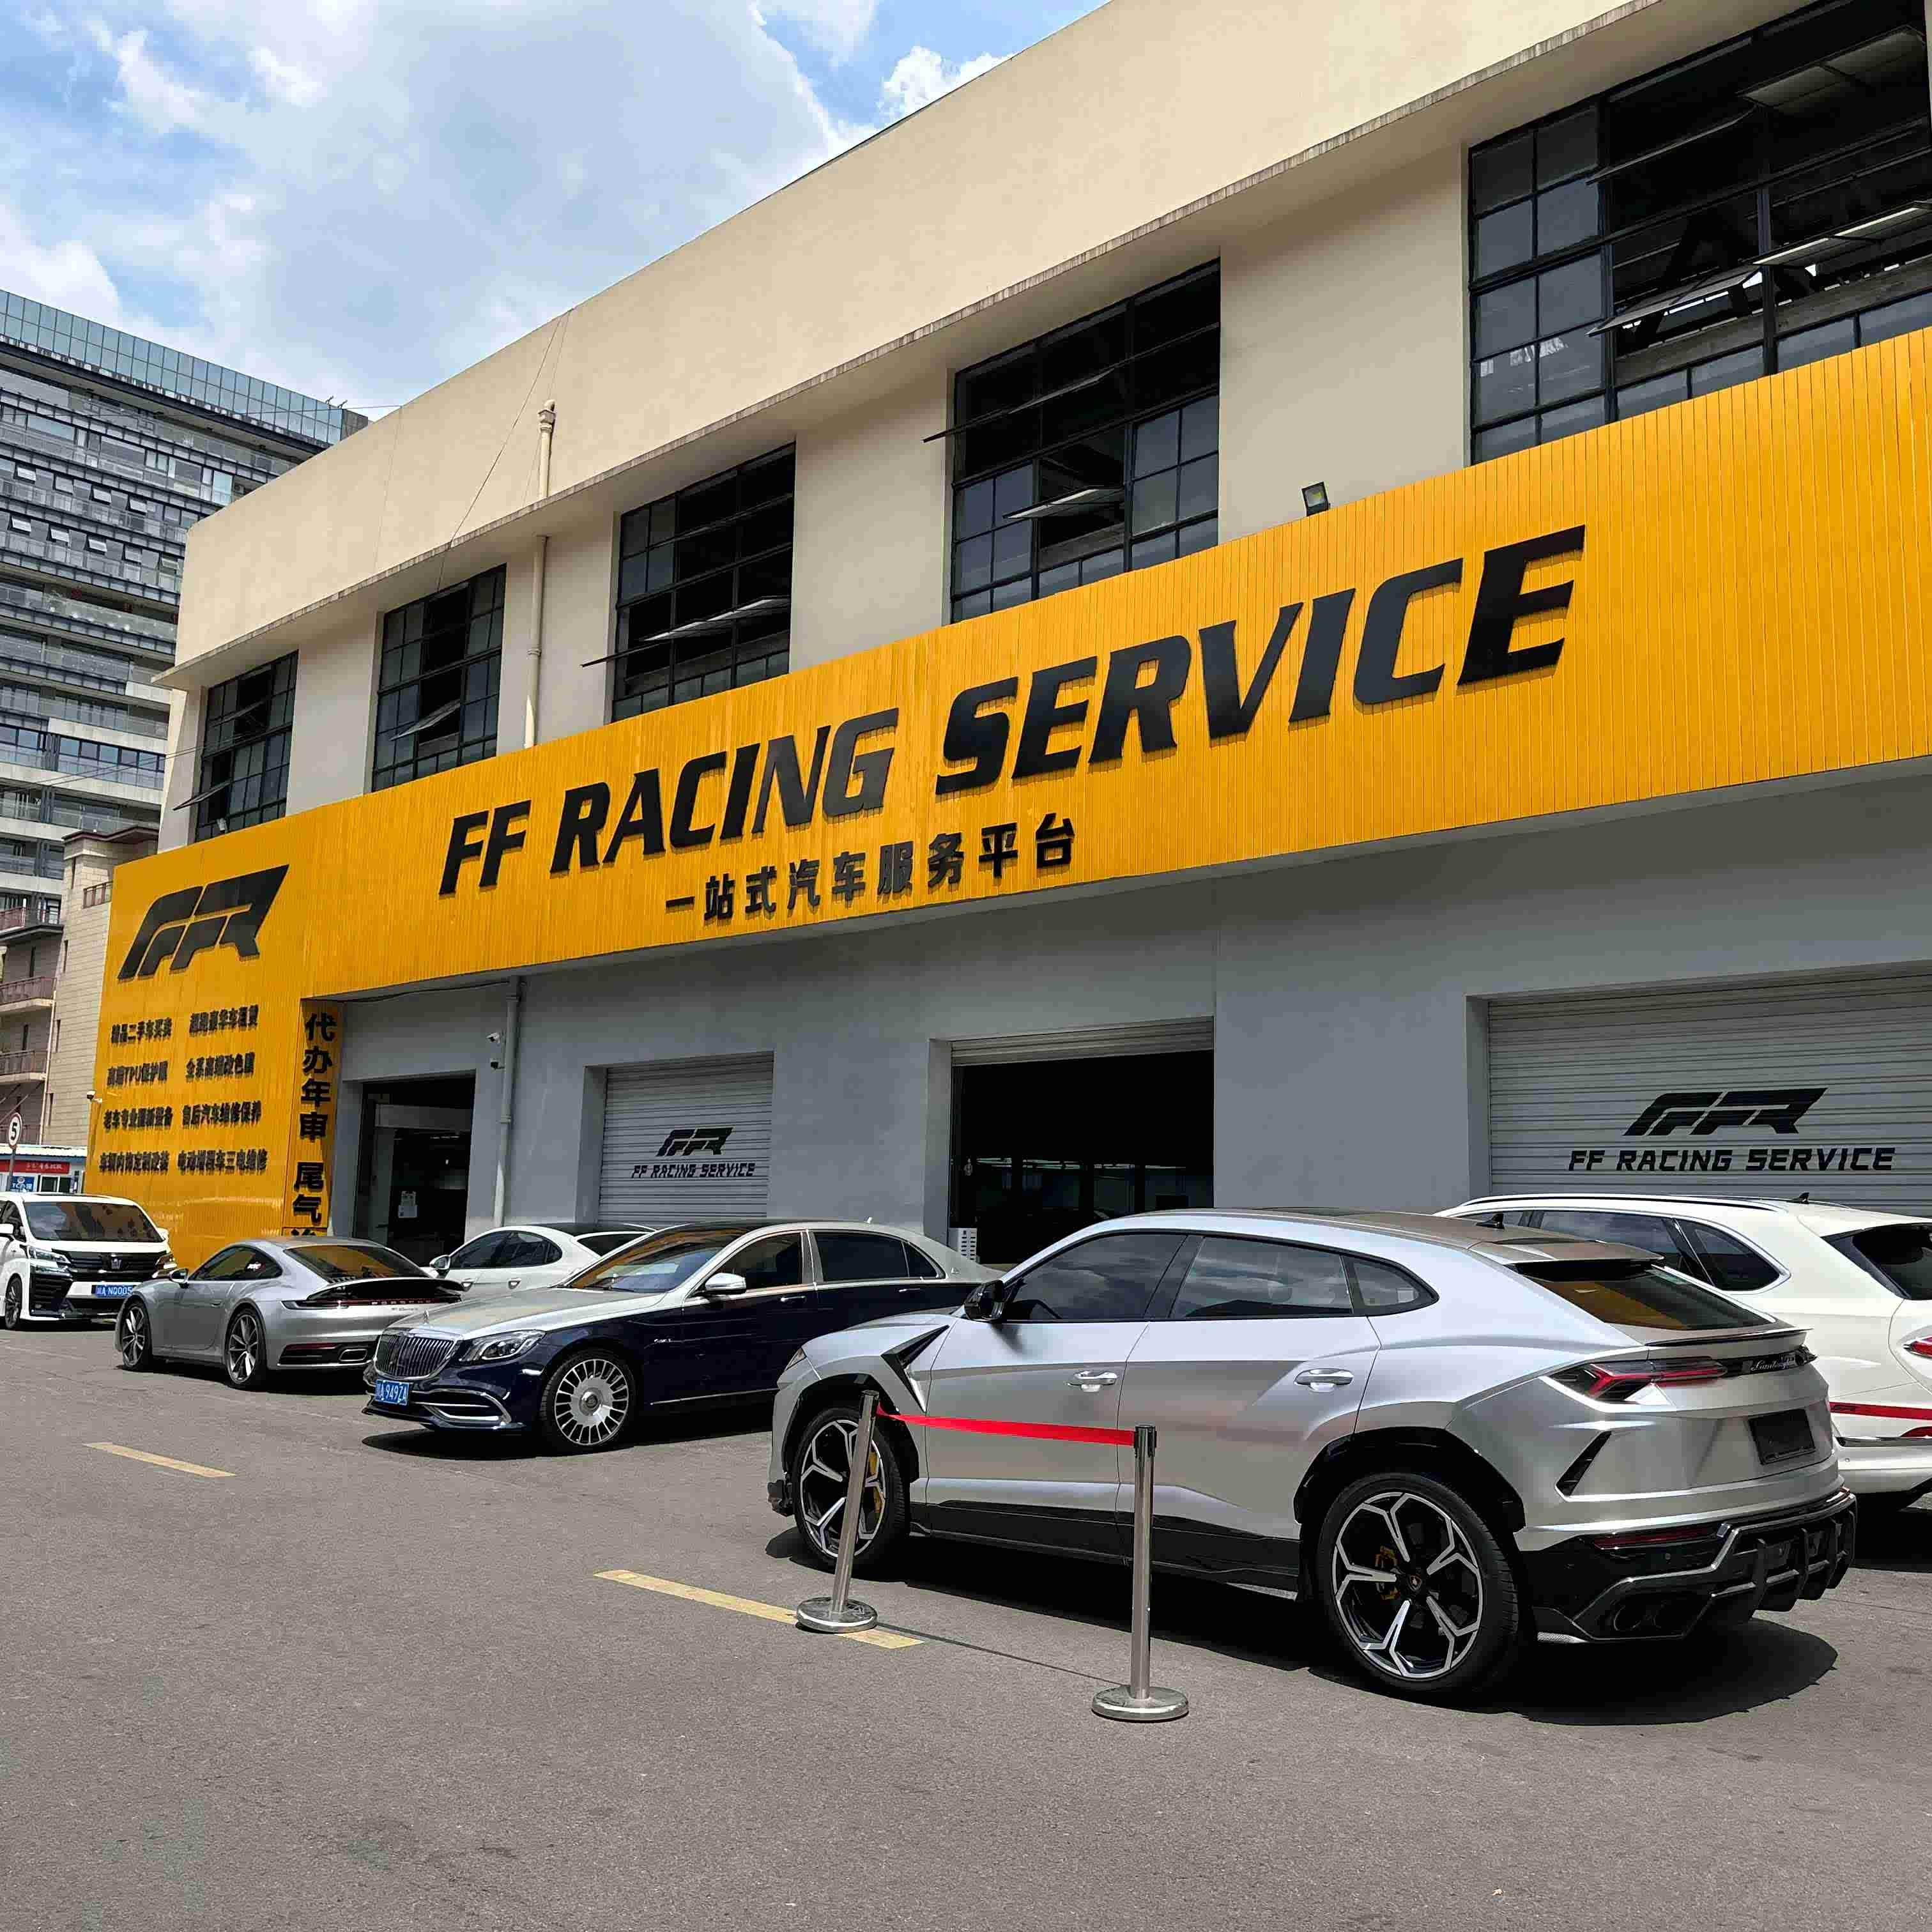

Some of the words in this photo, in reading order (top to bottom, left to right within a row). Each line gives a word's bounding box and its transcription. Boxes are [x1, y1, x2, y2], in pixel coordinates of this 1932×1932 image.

[438, 800, 531, 895] FF
[549, 707, 899, 873] RACING
[935, 525, 1584, 795] SERVICE
[666, 812, 1075, 921] 一站式汽车服务平台
[300, 1013, 336, 1142] 代办年审
[11, 1122, 17, 1140] 5
[183, 1100, 261, 1125] 售后汽车维修保养
[631, 1165, 648, 1178] FF
[650, 1164, 696, 1178] RACING
[700, 1163, 755, 1177] SERVICE
[1568, 1149, 1605, 1171] FF
[1616, 1149, 1732, 1171] RACING
[1745, 1147, 1896, 1170] SERVICE
[291, 1162, 325, 1236] 尾气
